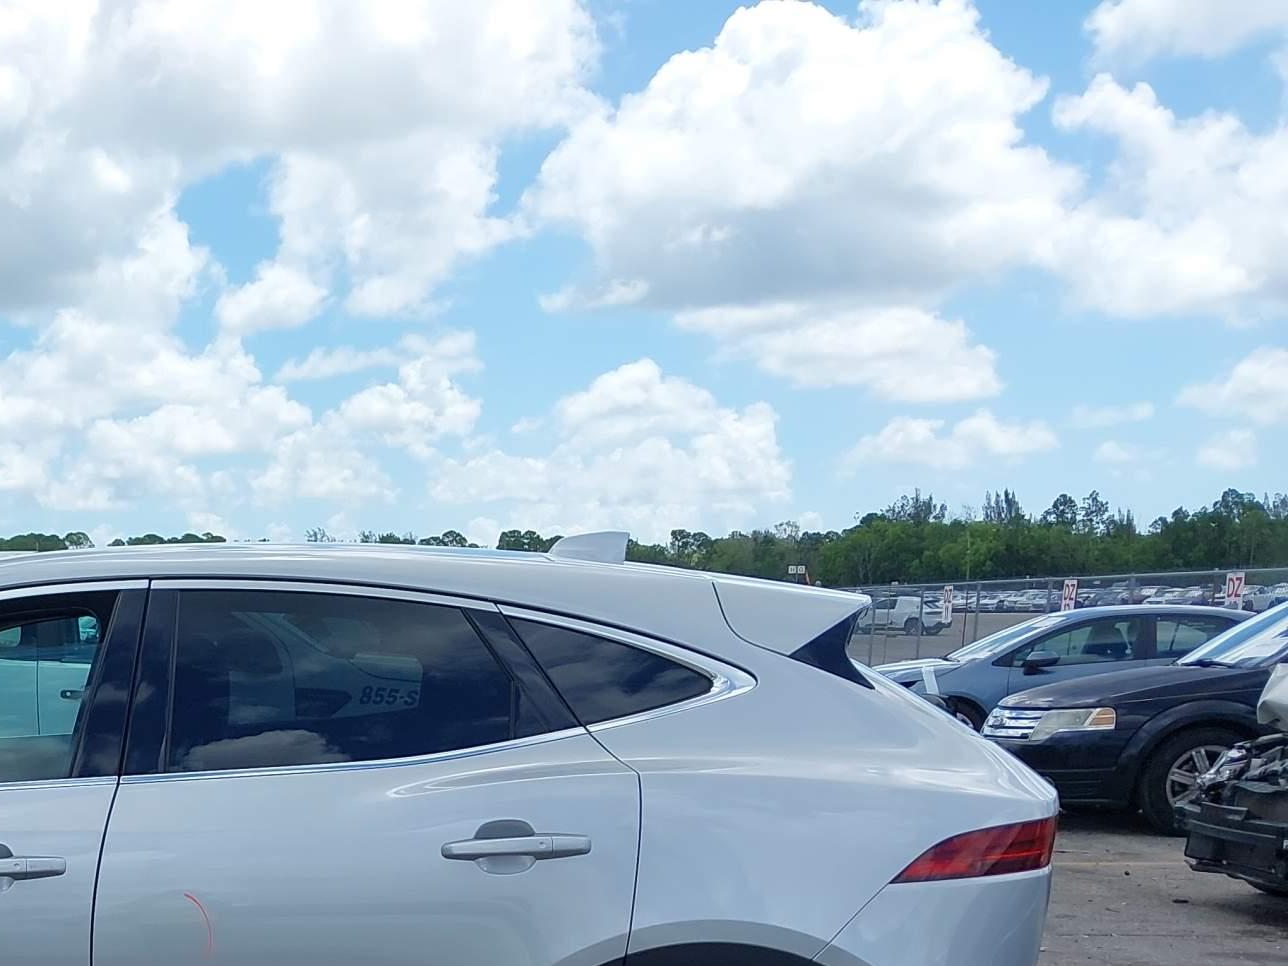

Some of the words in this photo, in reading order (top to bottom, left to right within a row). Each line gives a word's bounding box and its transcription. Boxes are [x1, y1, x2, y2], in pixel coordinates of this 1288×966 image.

[1064, 584, 1075, 600] DZ
[1227, 576, 1243, 598] DZ
[359, 686, 419, 706] 855-S
